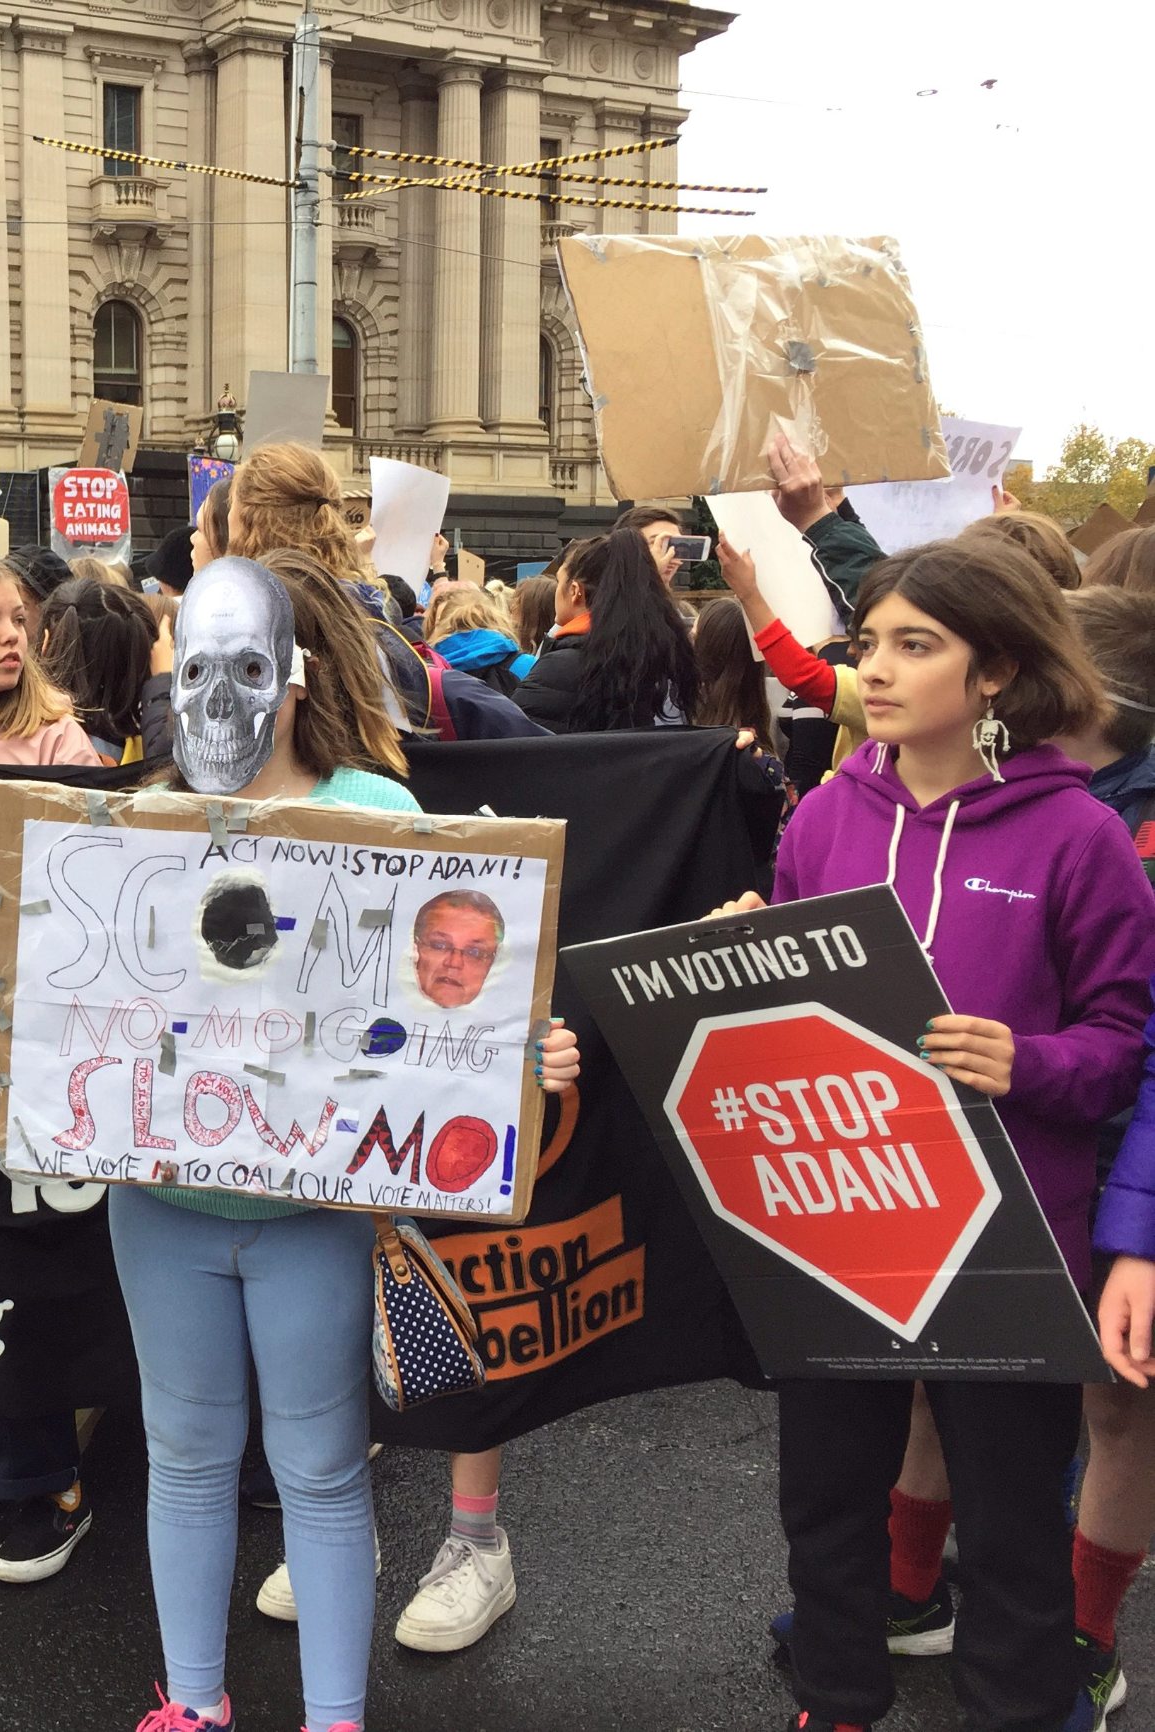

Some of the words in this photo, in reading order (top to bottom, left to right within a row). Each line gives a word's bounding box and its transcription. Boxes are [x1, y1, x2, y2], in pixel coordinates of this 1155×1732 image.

[63, 502, 122, 519] EATING
[64, 476, 118, 499] STOP
[65, 523, 122, 536] ANIMALS
[199, 836, 264, 869] ACT
[428, 856, 523, 881] ADANI!
[964, 877, 1037, 904] Champion
[611, 961, 675, 1005] I'M
[668, 935, 799, 996] VOTING
[805, 925, 869, 972] TO
[710, 1071, 899, 1146] #STOP
[34, 1149, 74, 1176] WE
[86, 1153, 142, 1181] VOTE
[183, 1159, 211, 1185] TO
[299, 1172, 354, 1204] OUR
[369, 1183, 413, 1205] VOTE
[416, 1191, 491, 1213] MATTERS!
[752, 1143, 940, 1217] ADANI
[444, 1232, 589, 1295] ction
[476, 1279, 638, 1370] bellion
